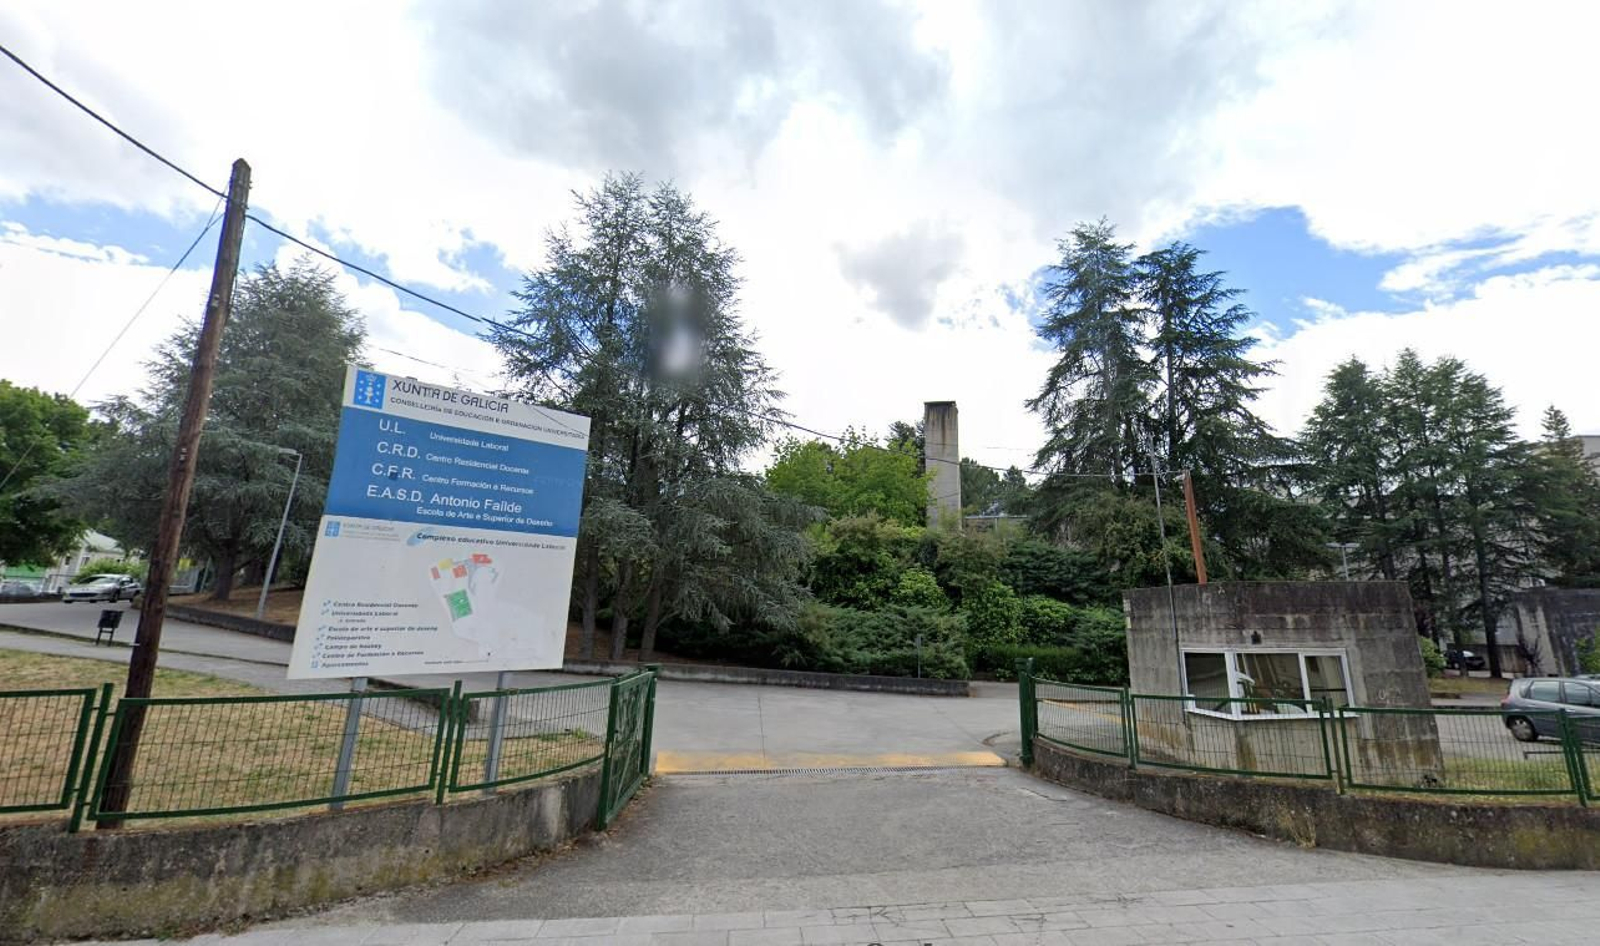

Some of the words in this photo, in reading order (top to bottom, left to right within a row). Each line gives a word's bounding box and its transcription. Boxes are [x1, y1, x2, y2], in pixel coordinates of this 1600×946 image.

[391, 380, 440, 400] XUNTA
[443, 390, 457, 403] DE
[461, 394, 509, 414] GALICIA
[379, 419, 406, 435] U.L.
[429, 431, 479, 447] Universidade
[481, 440, 509, 451] Laboral
[376, 441, 421, 459] C.R.D.
[425, 453, 452, 464] Centro
[454, 457, 499, 470] Residencial
[500, 464, 530, 474] Docente
[371, 463, 416, 480] C.F.R.
[422, 474, 449, 485] Centro
[500, 484, 534, 495] Recursos
[366, 484, 425, 503] E.A.S.D.
[429, 493, 481, 509] Antonio
[416, 507, 444, 517] Escola
[446, 510, 456, 518] de
[457, 511, 474, 520] Arte
[482, 514, 513, 525] Superior
[515, 516, 525, 525] de
[416, 532, 457, 543] Complexo
[457, 536, 495, 546] educativo
[495, 539, 541, 550] Universidade
